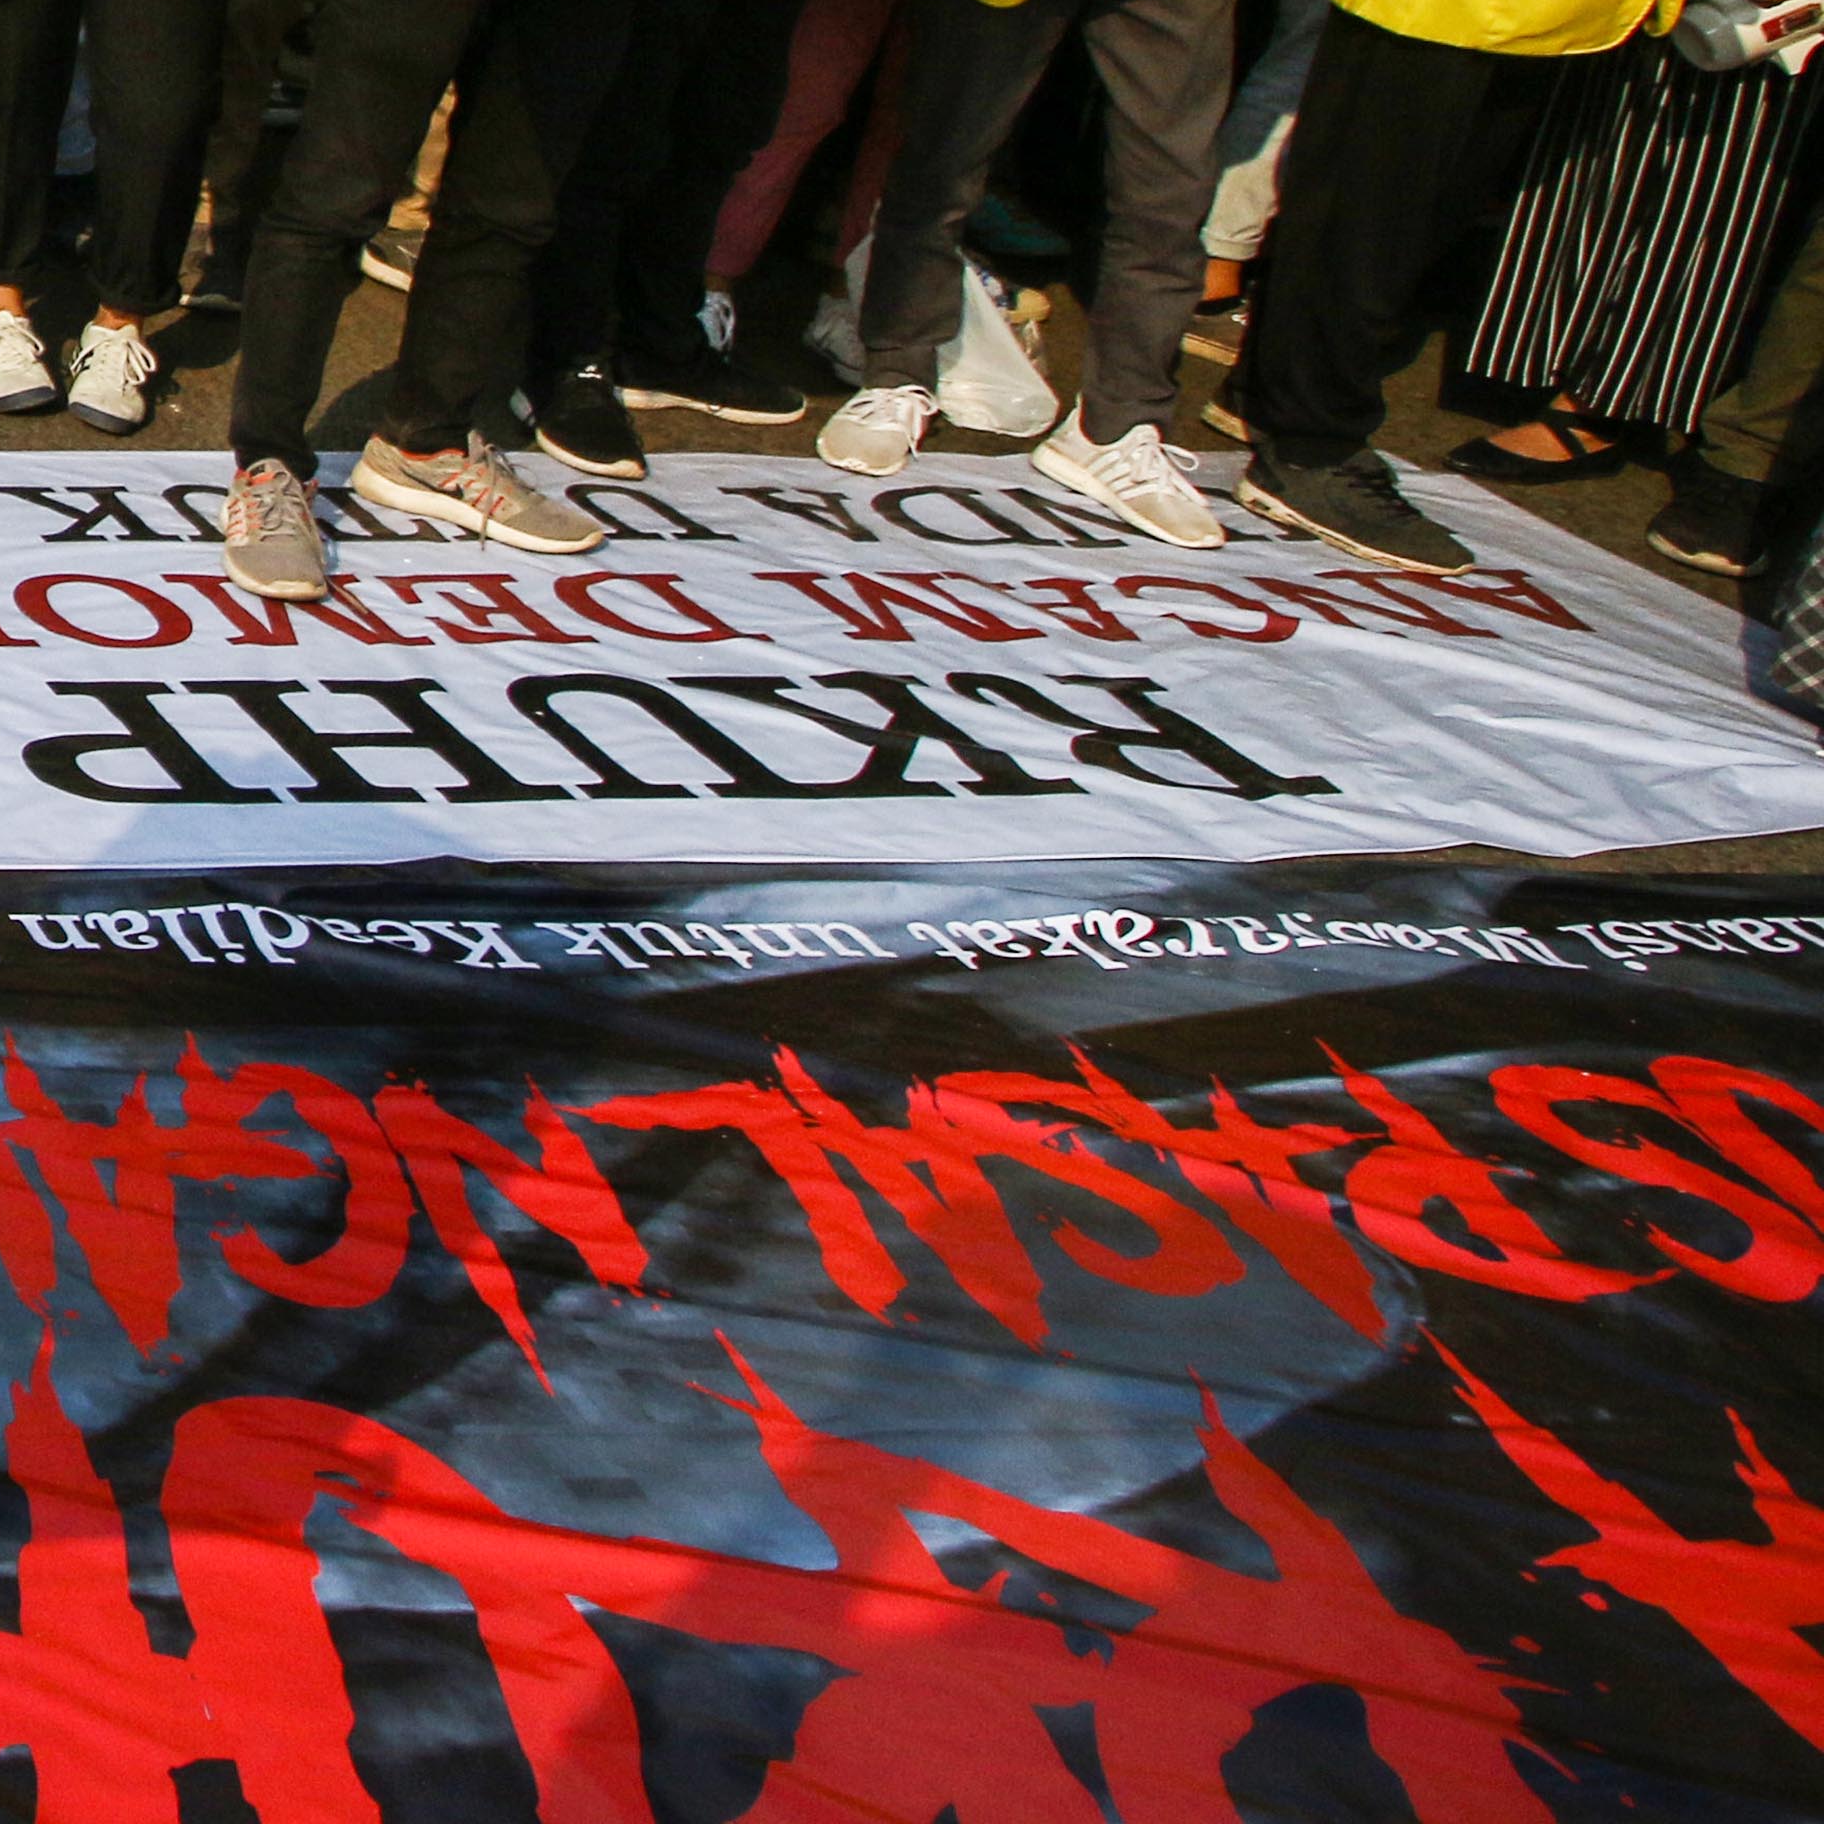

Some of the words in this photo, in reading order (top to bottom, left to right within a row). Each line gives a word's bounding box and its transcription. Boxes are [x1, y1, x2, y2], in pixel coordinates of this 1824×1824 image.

[21, 672, 1341, 806] RKUHP
[8, 901, 542, 970] Keadilan
[533, 919, 892, 971] untuk
[906, 907, 1589, 973] Masyarakat
[549, 1034, 1679, 1359] PASAL
